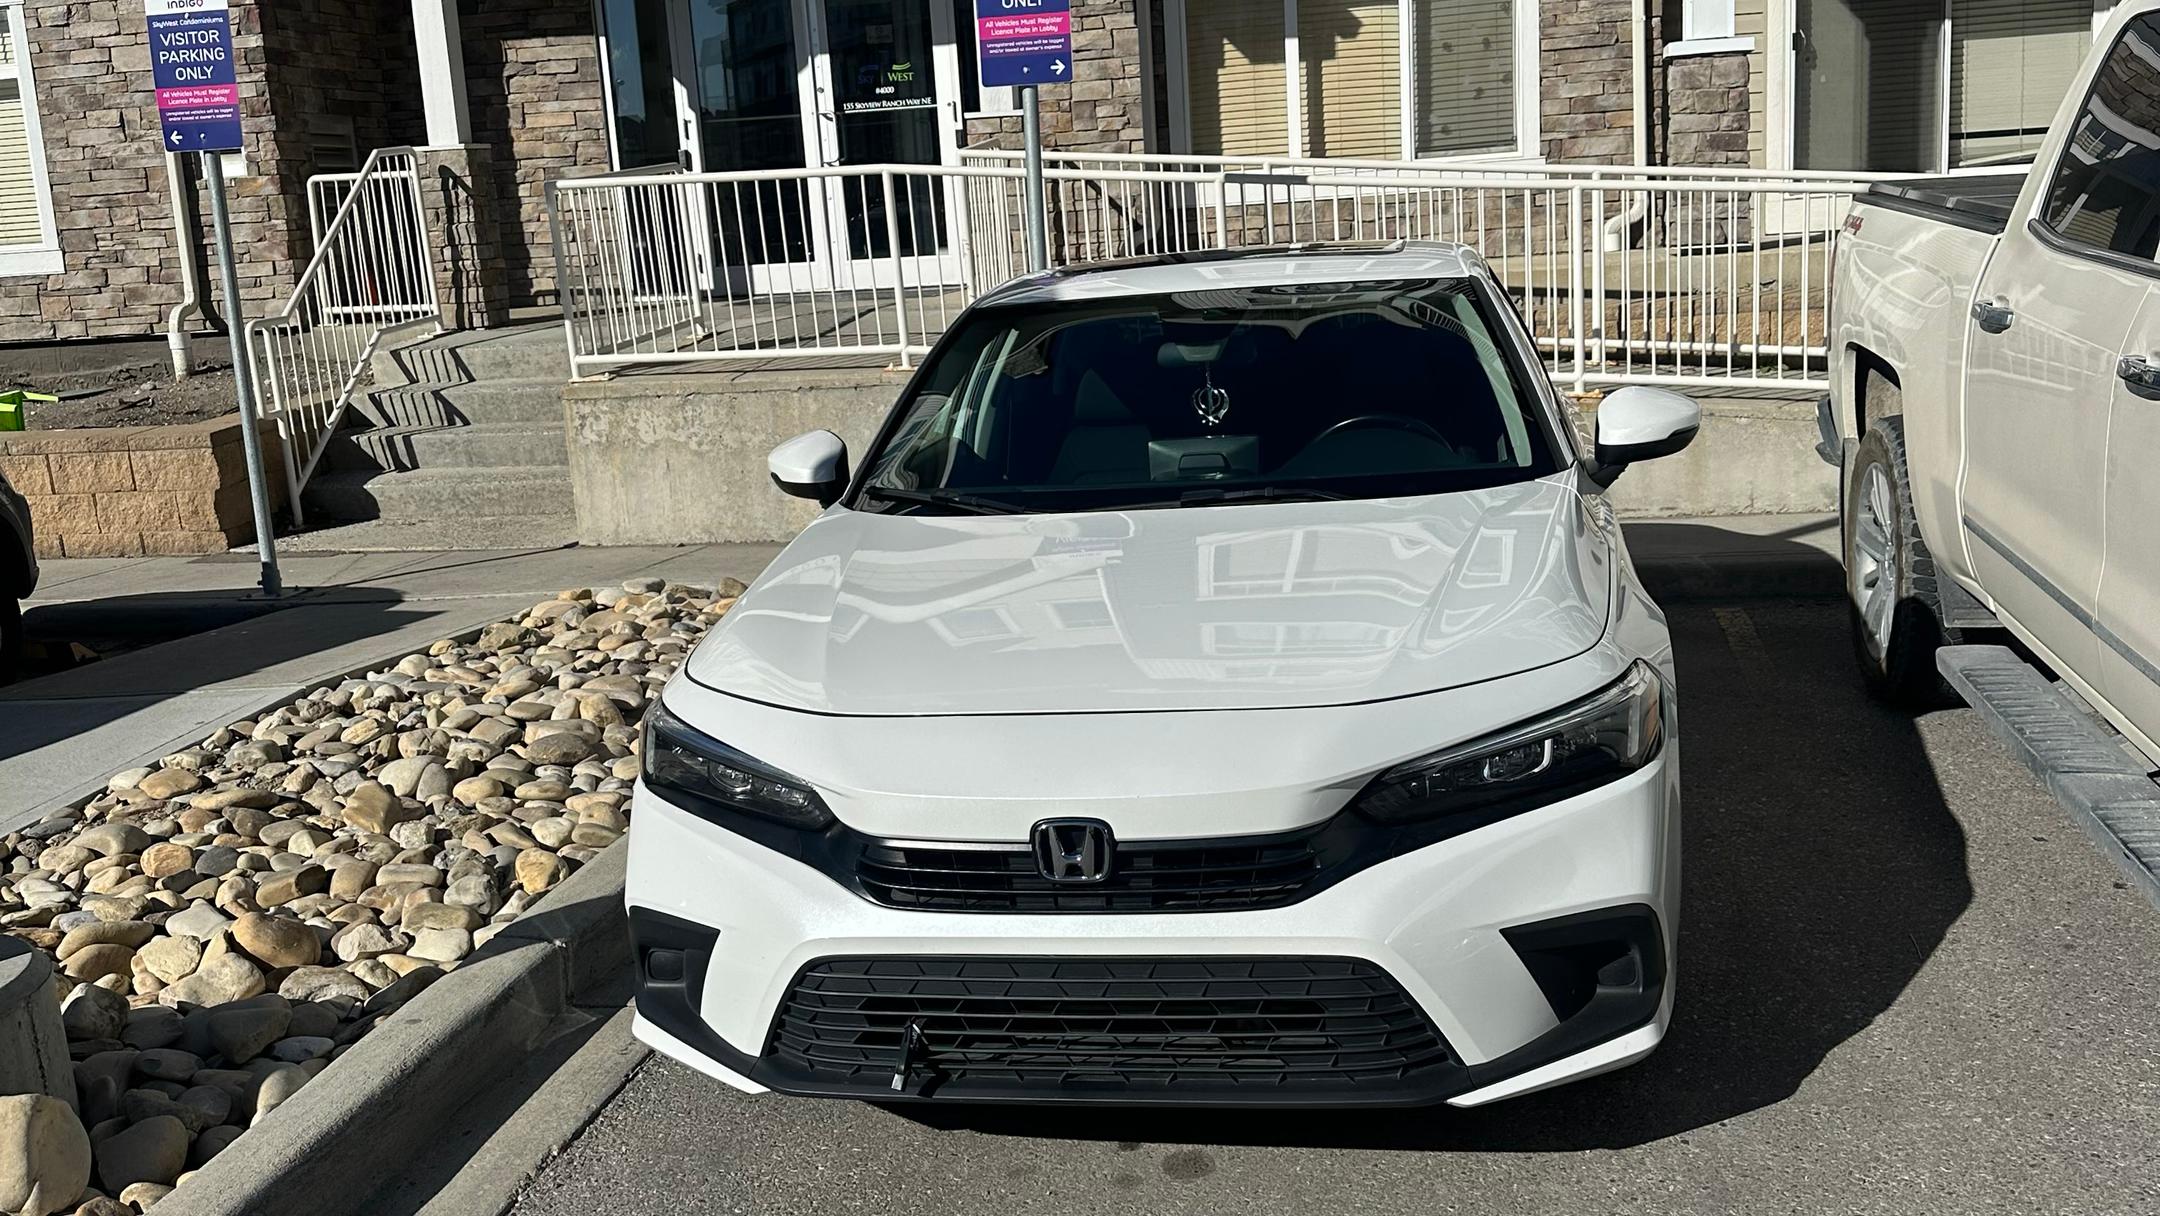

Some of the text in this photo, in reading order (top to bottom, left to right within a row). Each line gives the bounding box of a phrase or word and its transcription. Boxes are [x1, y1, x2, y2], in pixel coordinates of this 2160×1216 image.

[152, 17, 224, 29] SkyWest Condominiums
[1037, 16, 1064, 25] Register
[991, 28, 1014, 36] Licence
[1014, 26, 1031, 34] Plate
[1039, 24, 1059, 33] Lobby
[159, 30, 220, 47] VISITOR
[159, 47, 225, 64] PARKING
[175, 65, 214, 80] ONLY
[887, 72, 915, 82] WEST
[171, 90, 193, 98] Vehicles
[208, 88, 231, 96] Register
[168, 97, 188, 105] Licence
[843, 102, 854, 110] 155
[921, 96, 932, 105] NE
